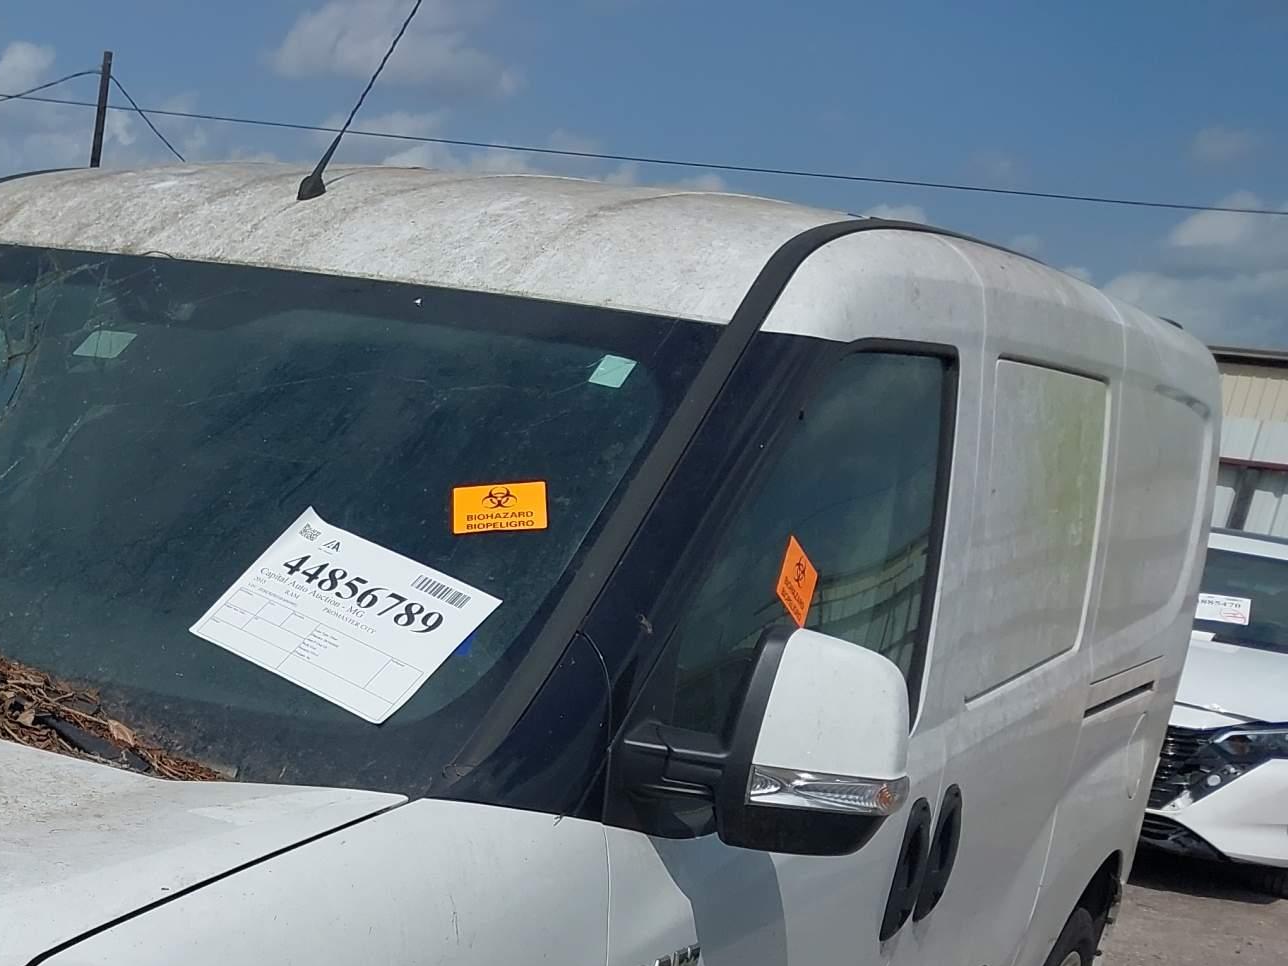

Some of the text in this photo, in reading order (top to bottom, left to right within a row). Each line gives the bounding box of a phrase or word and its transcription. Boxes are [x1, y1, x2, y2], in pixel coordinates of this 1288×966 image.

[466, 511, 534, 521] BIOHAZARD
[466, 520, 534, 530] BIOPELIGRO
[260, 567, 290, 584] Capital
[287, 580, 308, 593] Auto
[308, 590, 341, 607] Auction
[346, 604, 365, 618] MG
[283, 554, 444, 633] 44856789
